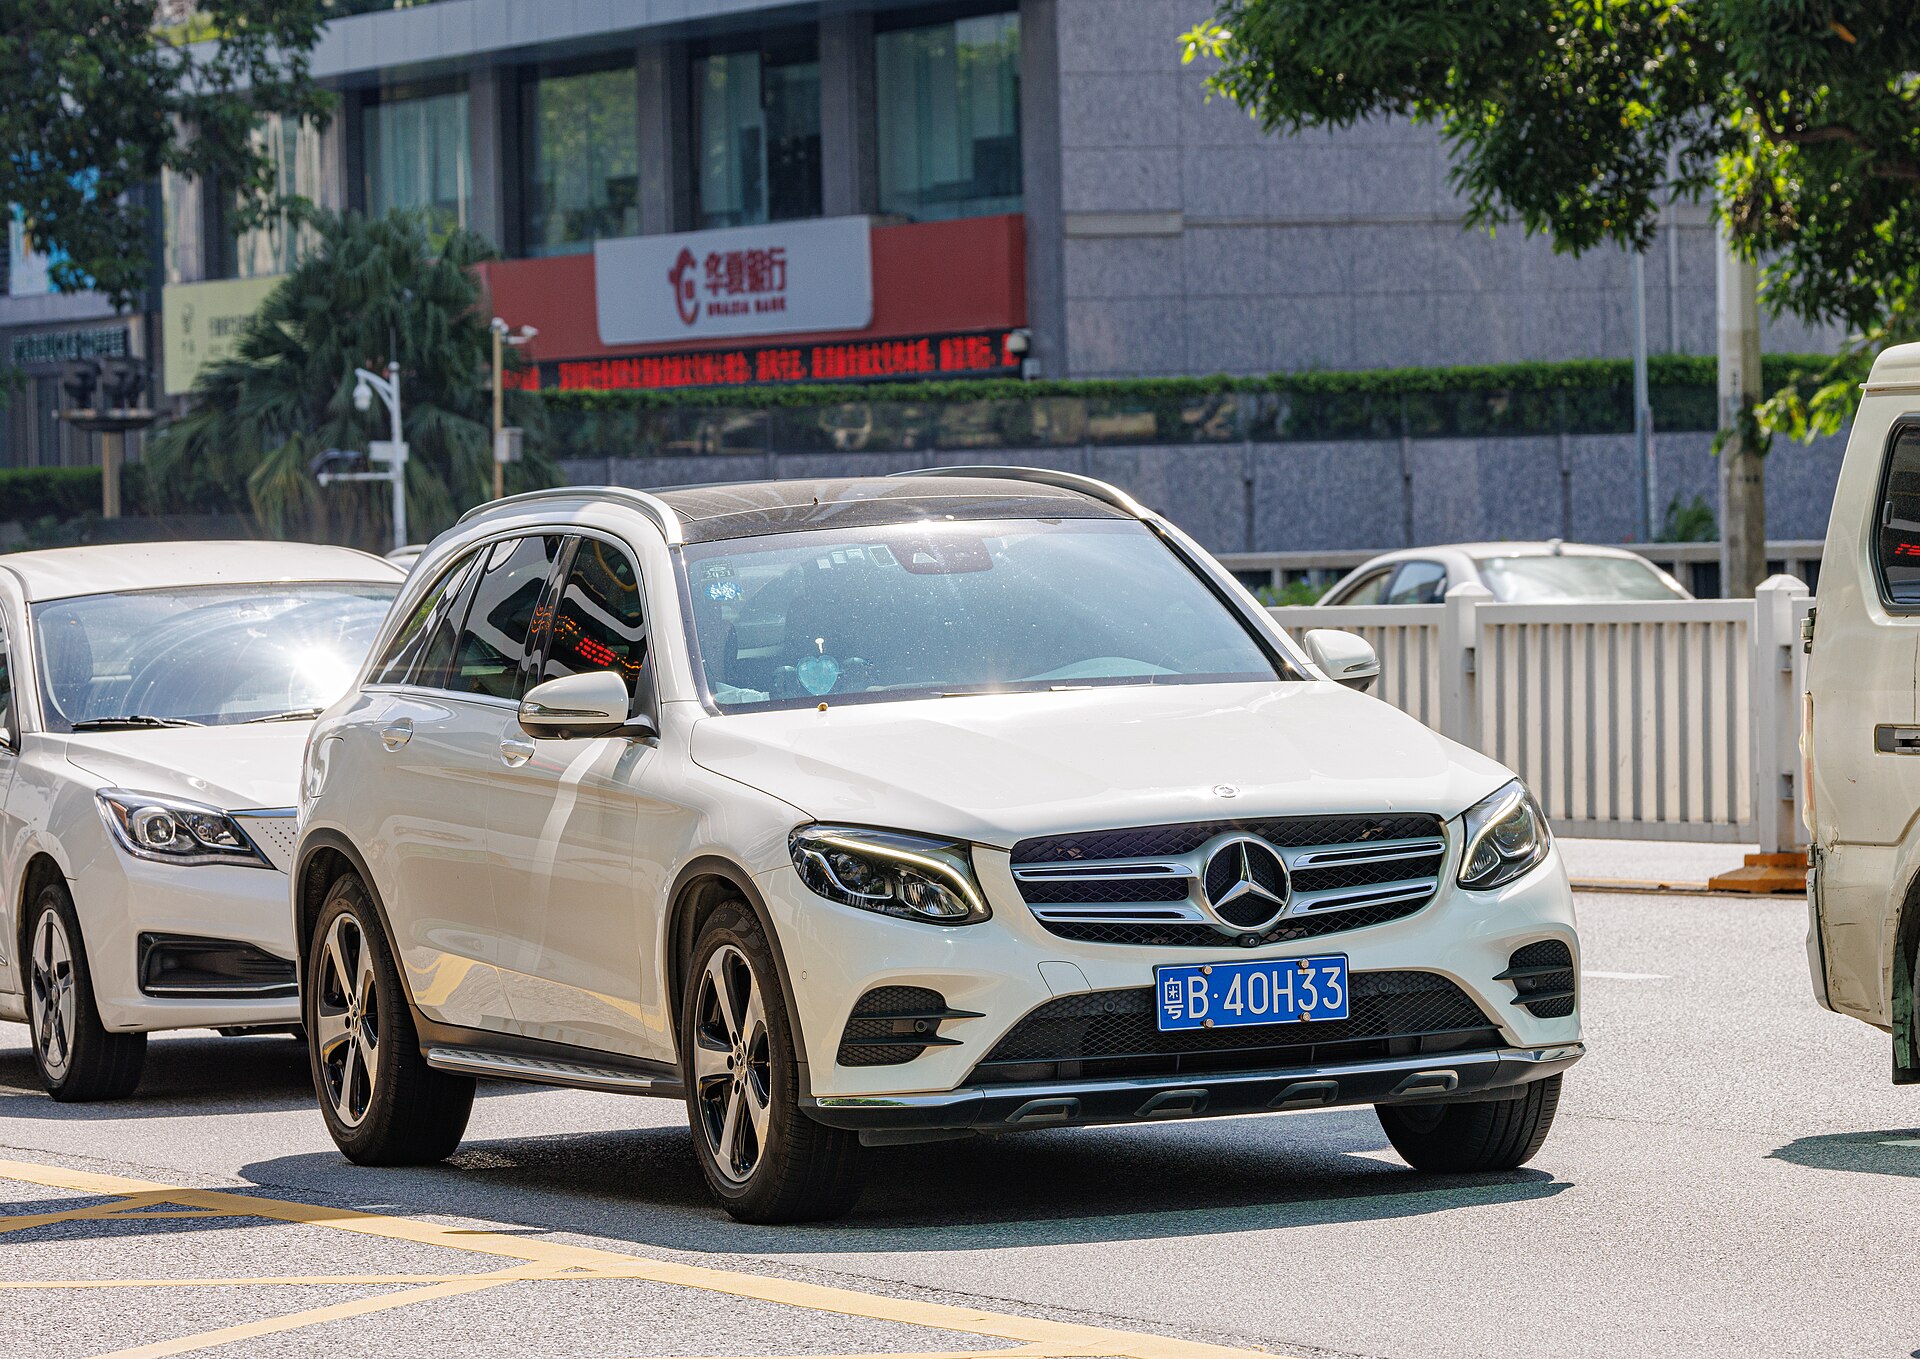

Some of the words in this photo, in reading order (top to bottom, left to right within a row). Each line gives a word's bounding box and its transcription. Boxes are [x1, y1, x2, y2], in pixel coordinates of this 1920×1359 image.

[704, 246, 787, 297] 华夏银行
[1163, 966, 1344, 1020] 粤B·40H33
